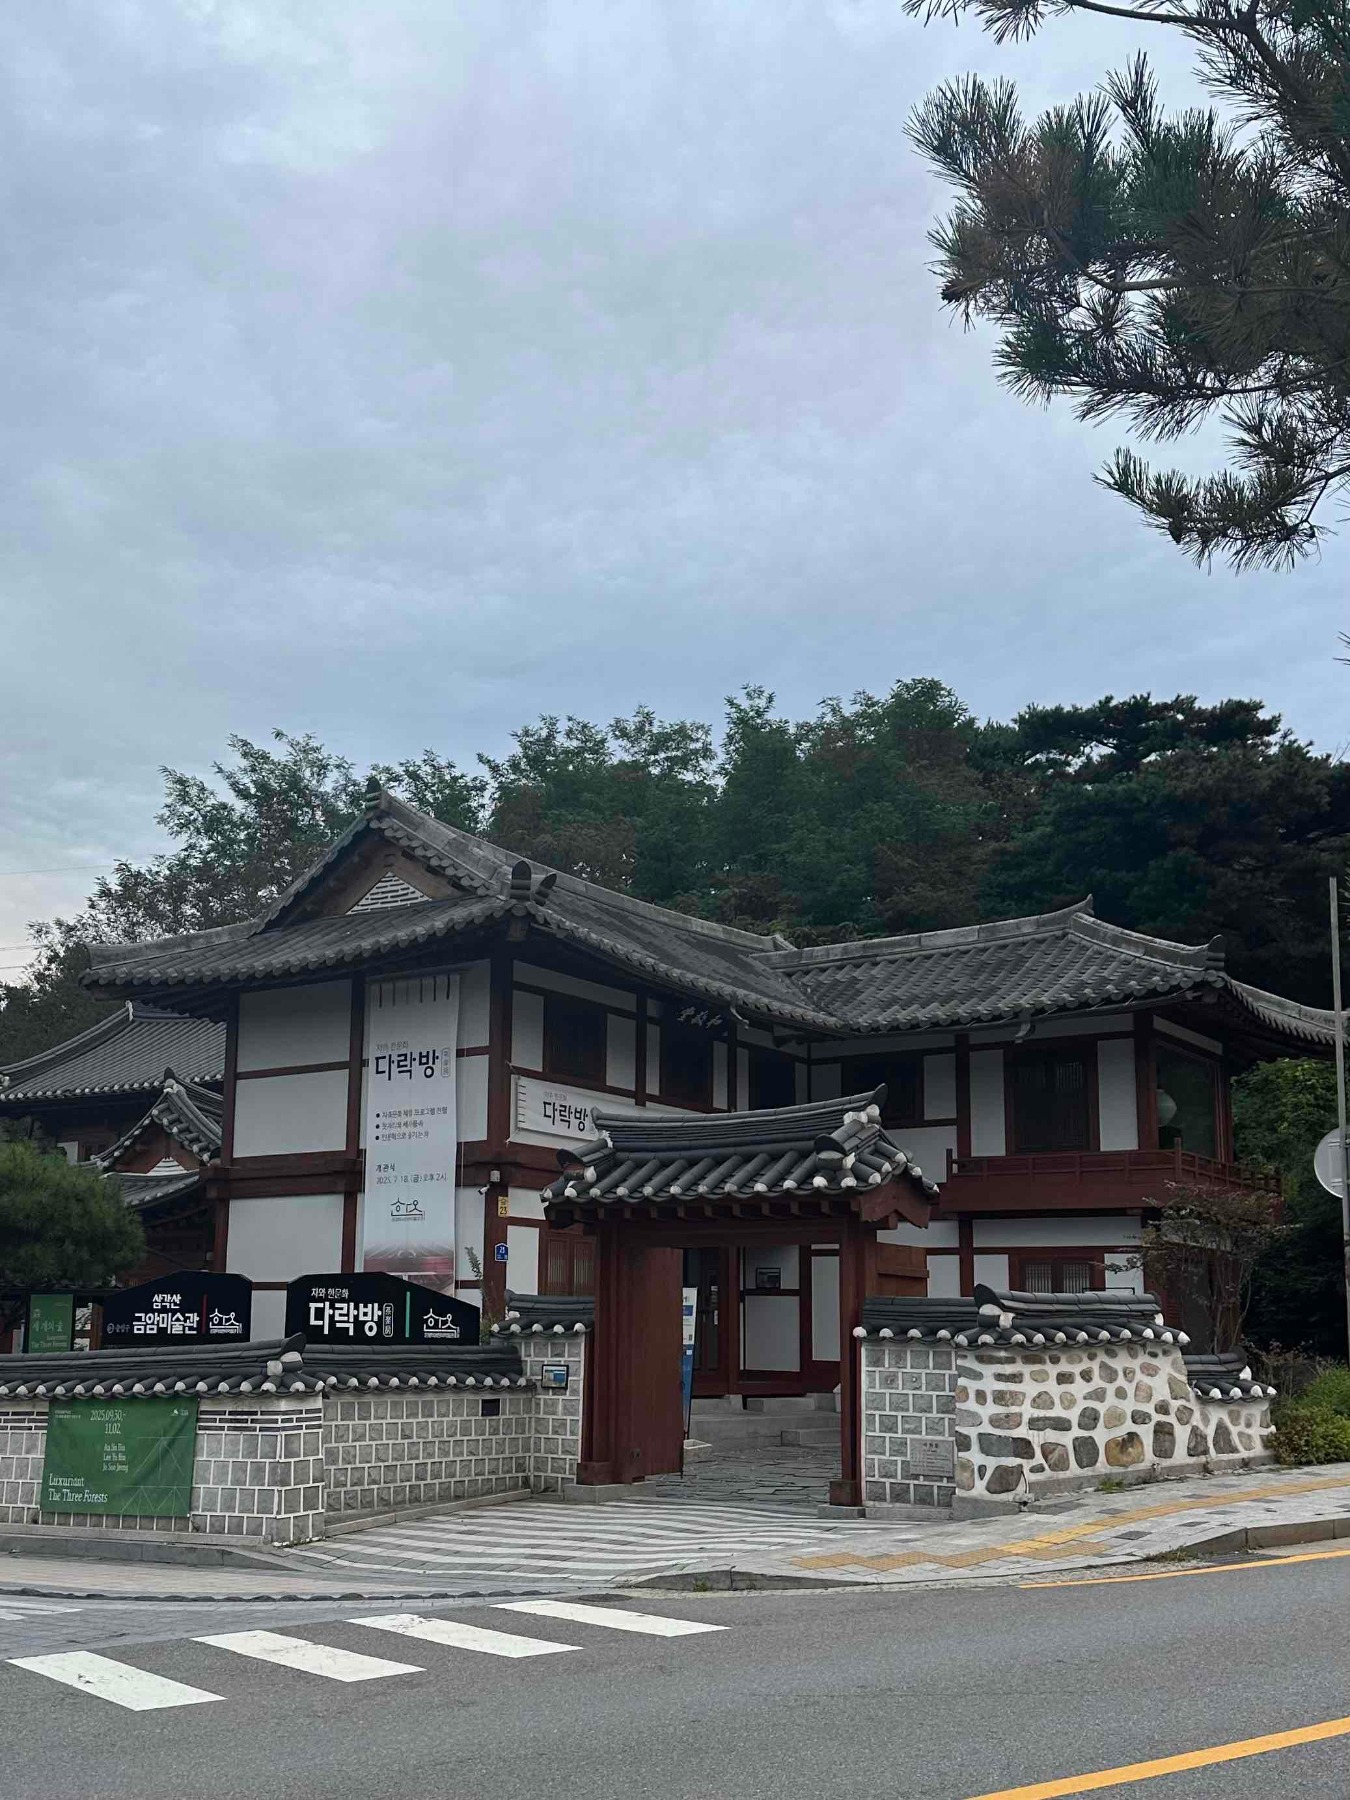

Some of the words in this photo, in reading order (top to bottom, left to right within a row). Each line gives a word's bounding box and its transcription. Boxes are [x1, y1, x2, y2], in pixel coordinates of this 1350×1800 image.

[375, 1049, 440, 1081] 다락방
[543, 1100, 589, 1132] 다락방
[152, 1294, 182, 1309] 삼각산
[132, 1312, 200, 1335] 금암미술관
[309, 1301, 383, 1337] 다락방
[48, 1488, 61, 1501] The
[62, 1489, 83, 1502] Three
[83, 1490, 109, 1503] Forests
